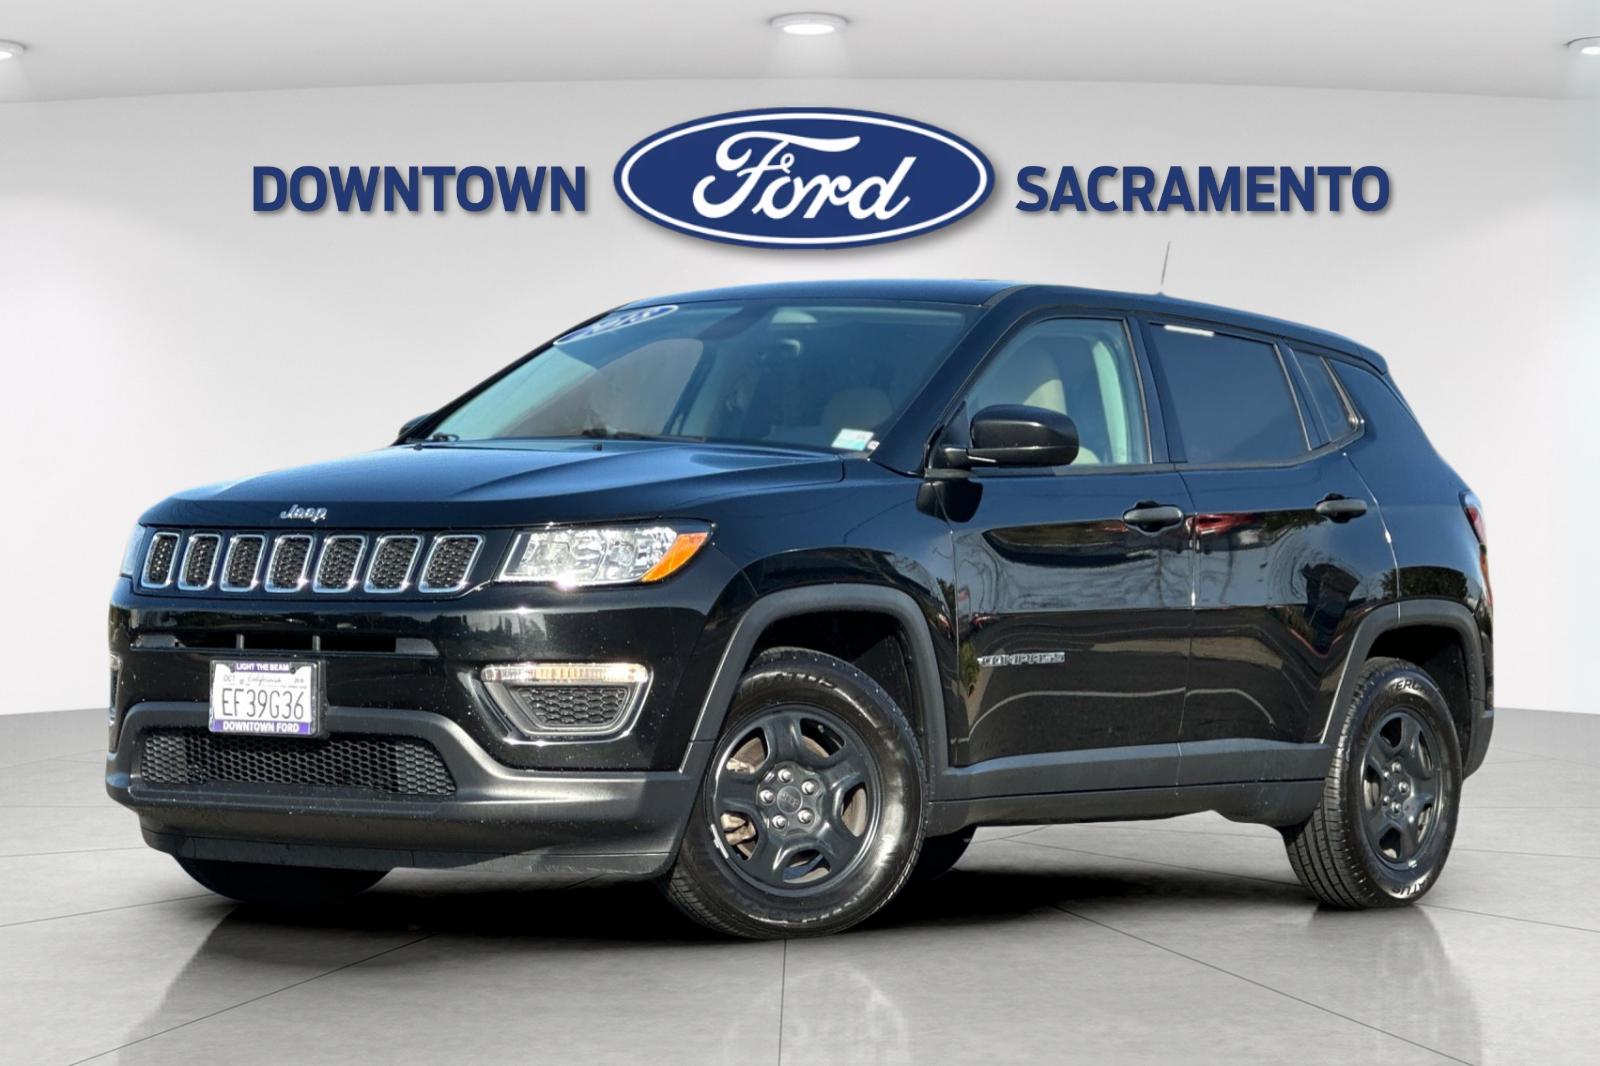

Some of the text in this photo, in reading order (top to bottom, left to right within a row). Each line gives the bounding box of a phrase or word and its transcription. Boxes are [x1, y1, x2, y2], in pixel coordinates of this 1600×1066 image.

[253, 130, 1391, 220] DOWNTOWN Ford SACRAMENTO
[280, 503, 328, 524] Jeep
[236, 663, 290, 671] LIGHT THE BEAM
[222, 688, 305, 720] EF39G36
[222, 721, 300, 733] DOWNTOWN FORD
